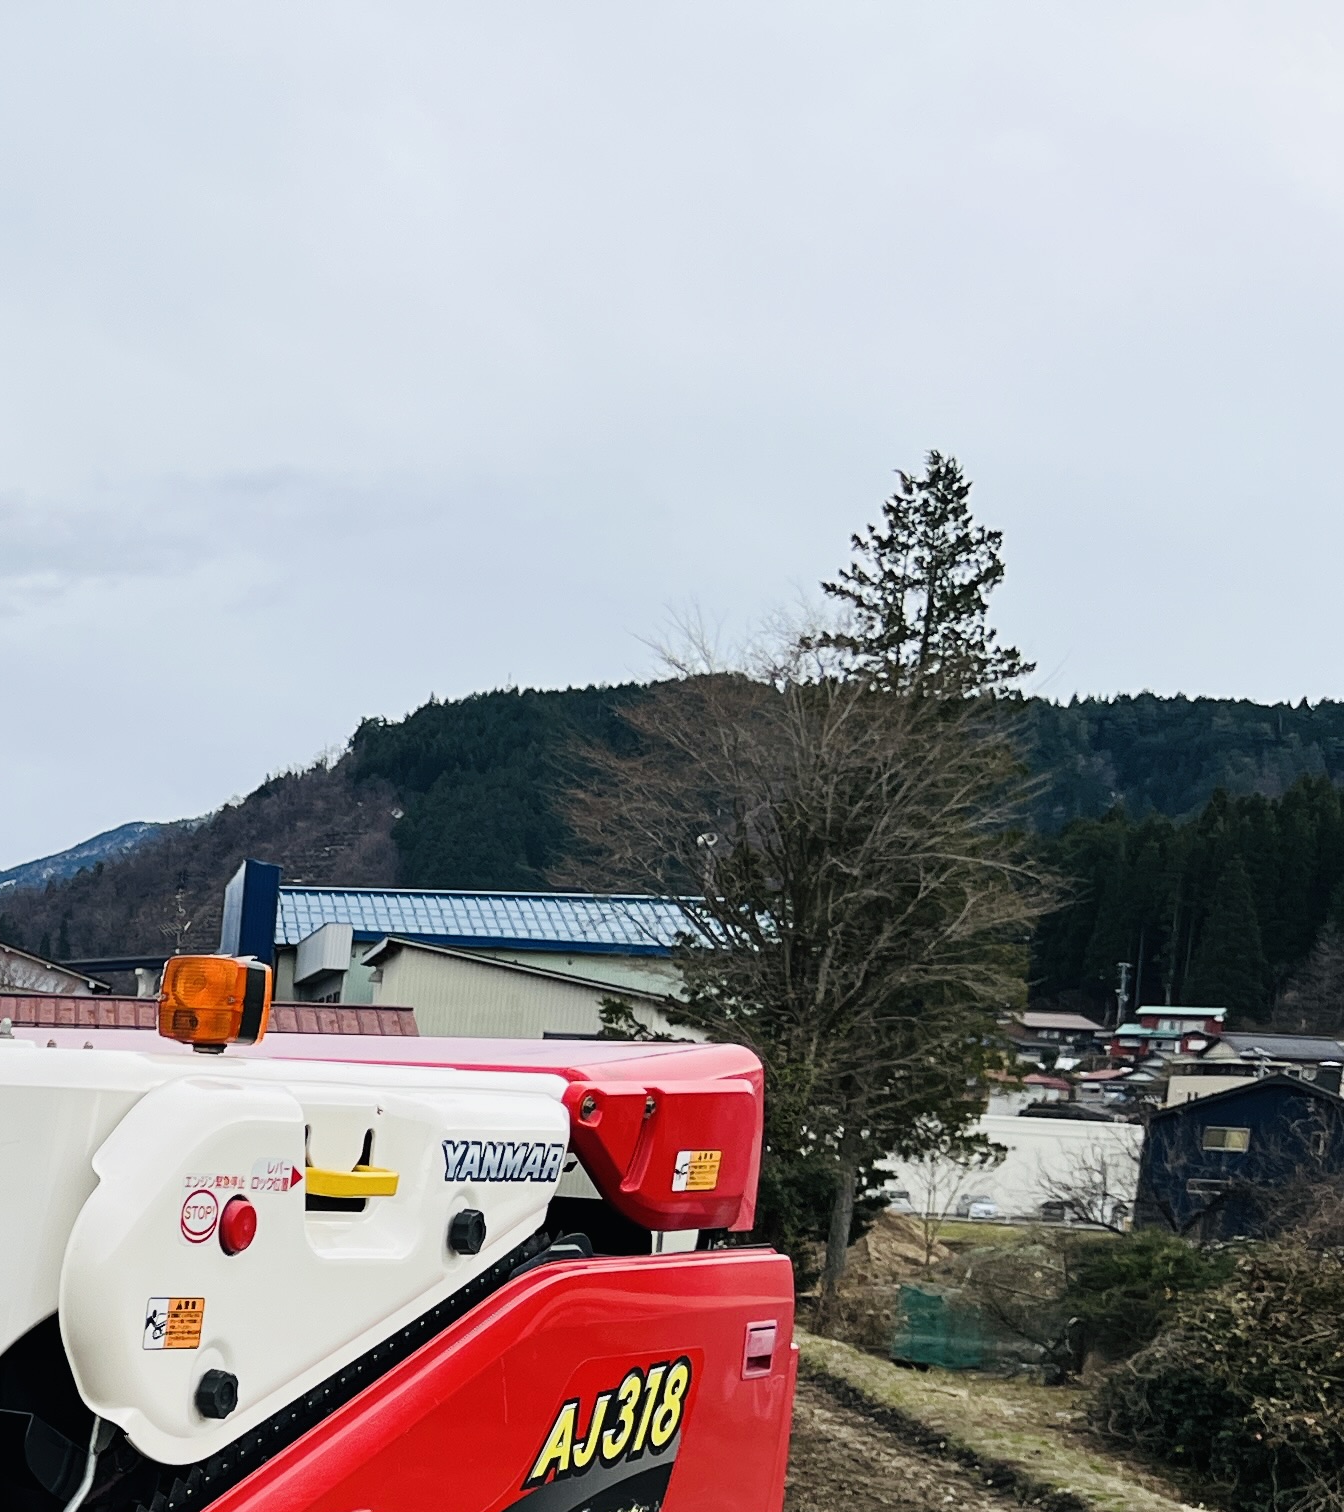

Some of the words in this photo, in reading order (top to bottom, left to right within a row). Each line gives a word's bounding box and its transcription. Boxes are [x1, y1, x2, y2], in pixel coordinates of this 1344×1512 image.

[267, 1161, 290, 1175] レバー
[442, 1140, 565, 1182] YANMAR
[185, 1175, 246, 1189] エンジン緊急停止
[251, 1176, 289, 1191] ロック位置
[184, 1205, 216, 1220] STOP!
[521, 1357, 691, 1490] AJ318
